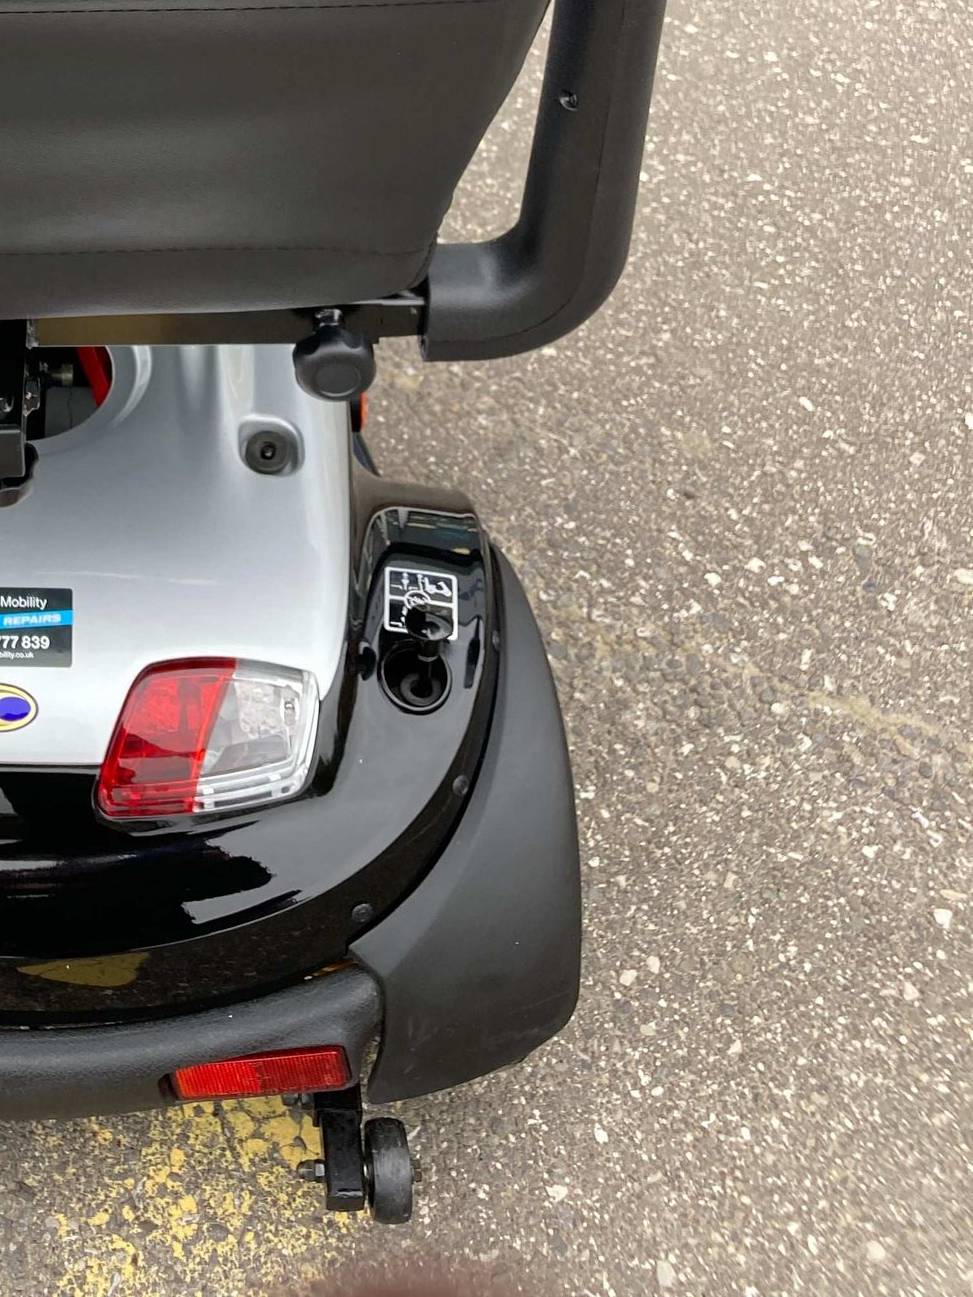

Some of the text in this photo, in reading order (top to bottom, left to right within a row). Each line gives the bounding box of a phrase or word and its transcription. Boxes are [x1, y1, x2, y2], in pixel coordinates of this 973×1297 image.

[0, 595, 48, 610] Mobility
[3, 613, 62, 626] REPAIRS
[21, 635, 51, 650] 839
